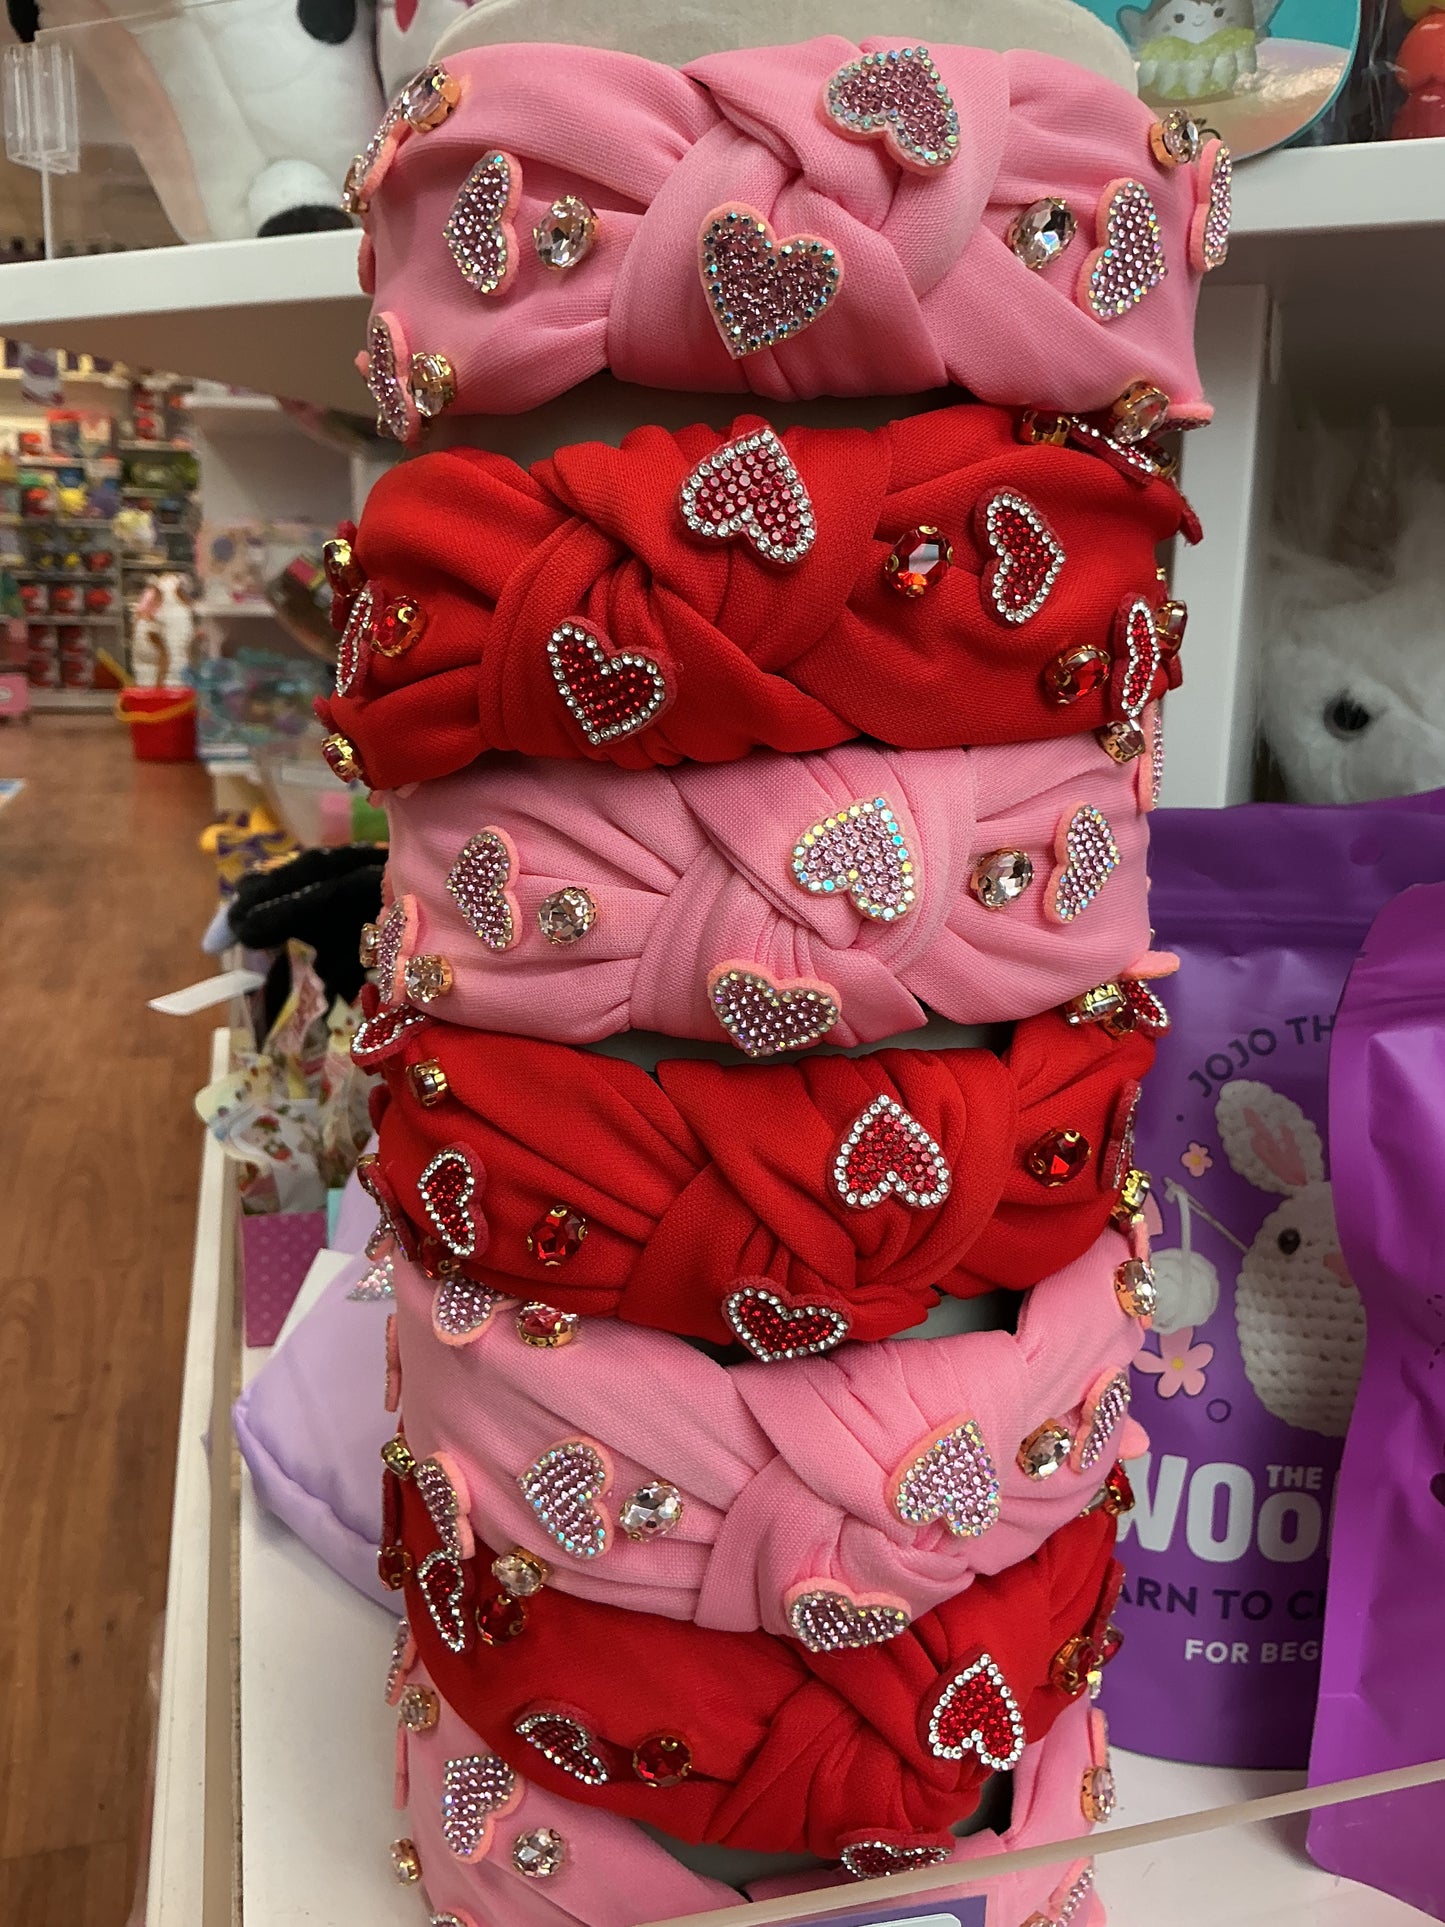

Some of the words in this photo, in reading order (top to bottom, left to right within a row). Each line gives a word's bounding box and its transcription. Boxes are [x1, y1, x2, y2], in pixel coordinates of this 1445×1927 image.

[1188, 1028, 1277, 1098] JOJO
[1266, 1464, 1324, 1491] THE
[1116, 1450, 1340, 1563] WOO
[1212, 1589, 1273, 1622] TO
[1184, 1638, 1249, 1664] FOR
